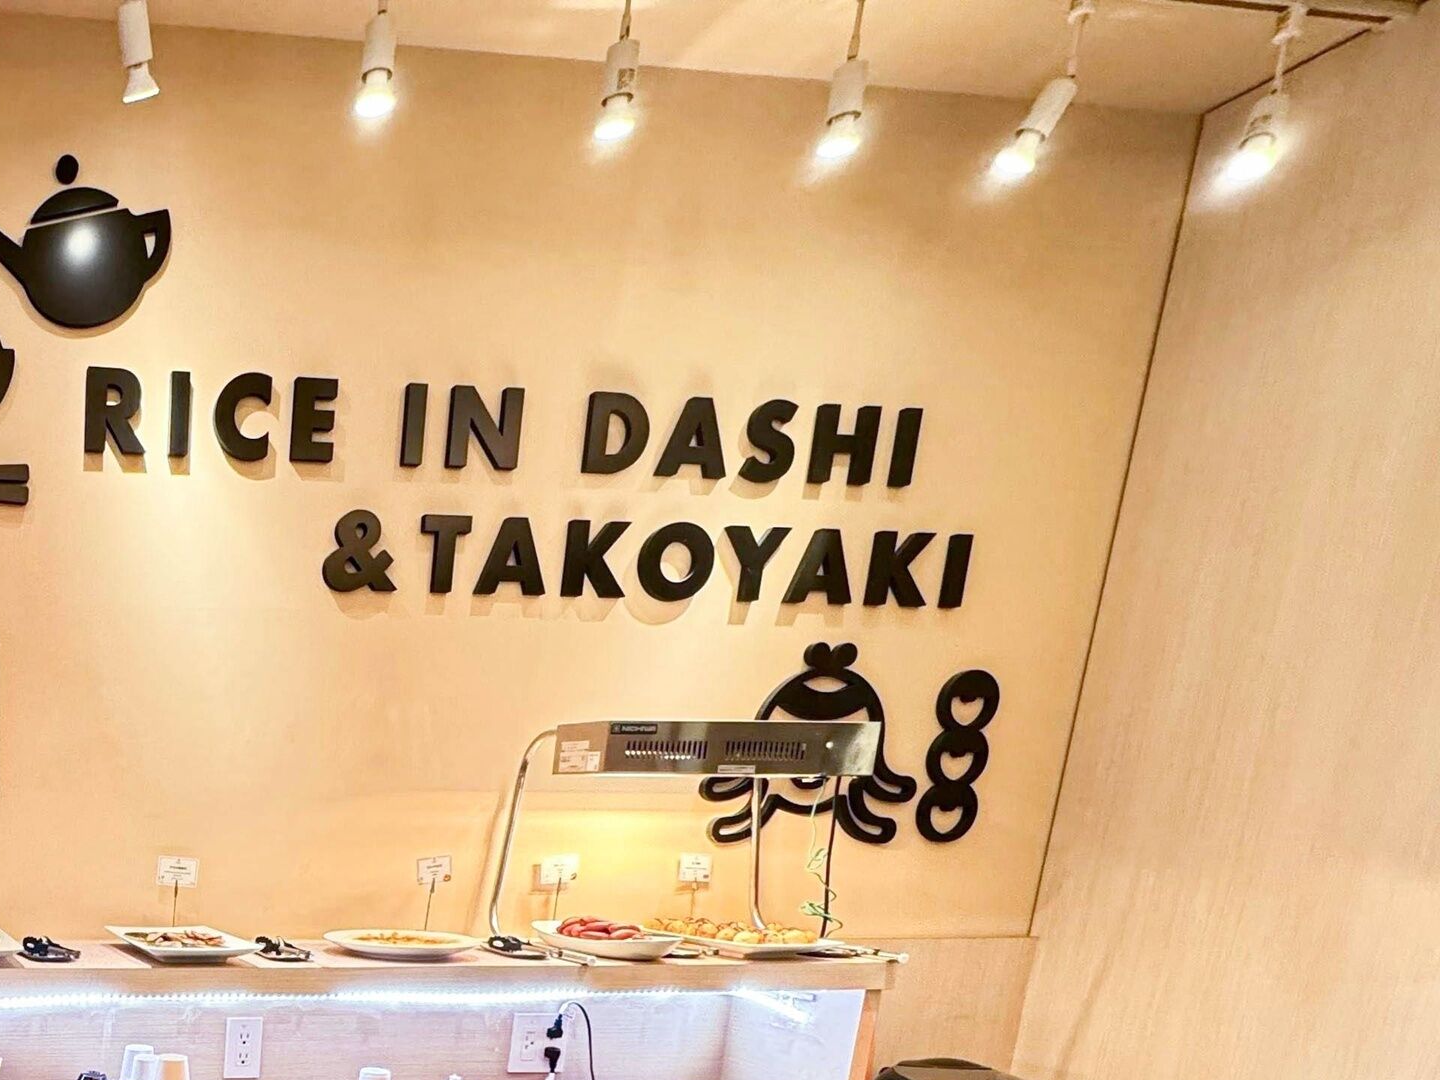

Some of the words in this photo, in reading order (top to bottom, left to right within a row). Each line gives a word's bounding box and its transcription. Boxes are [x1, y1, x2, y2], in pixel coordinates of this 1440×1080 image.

[84, 365, 339, 464] RICE
[399, 382, 526, 471] IN
[580, 391, 924, 488] DASHI
